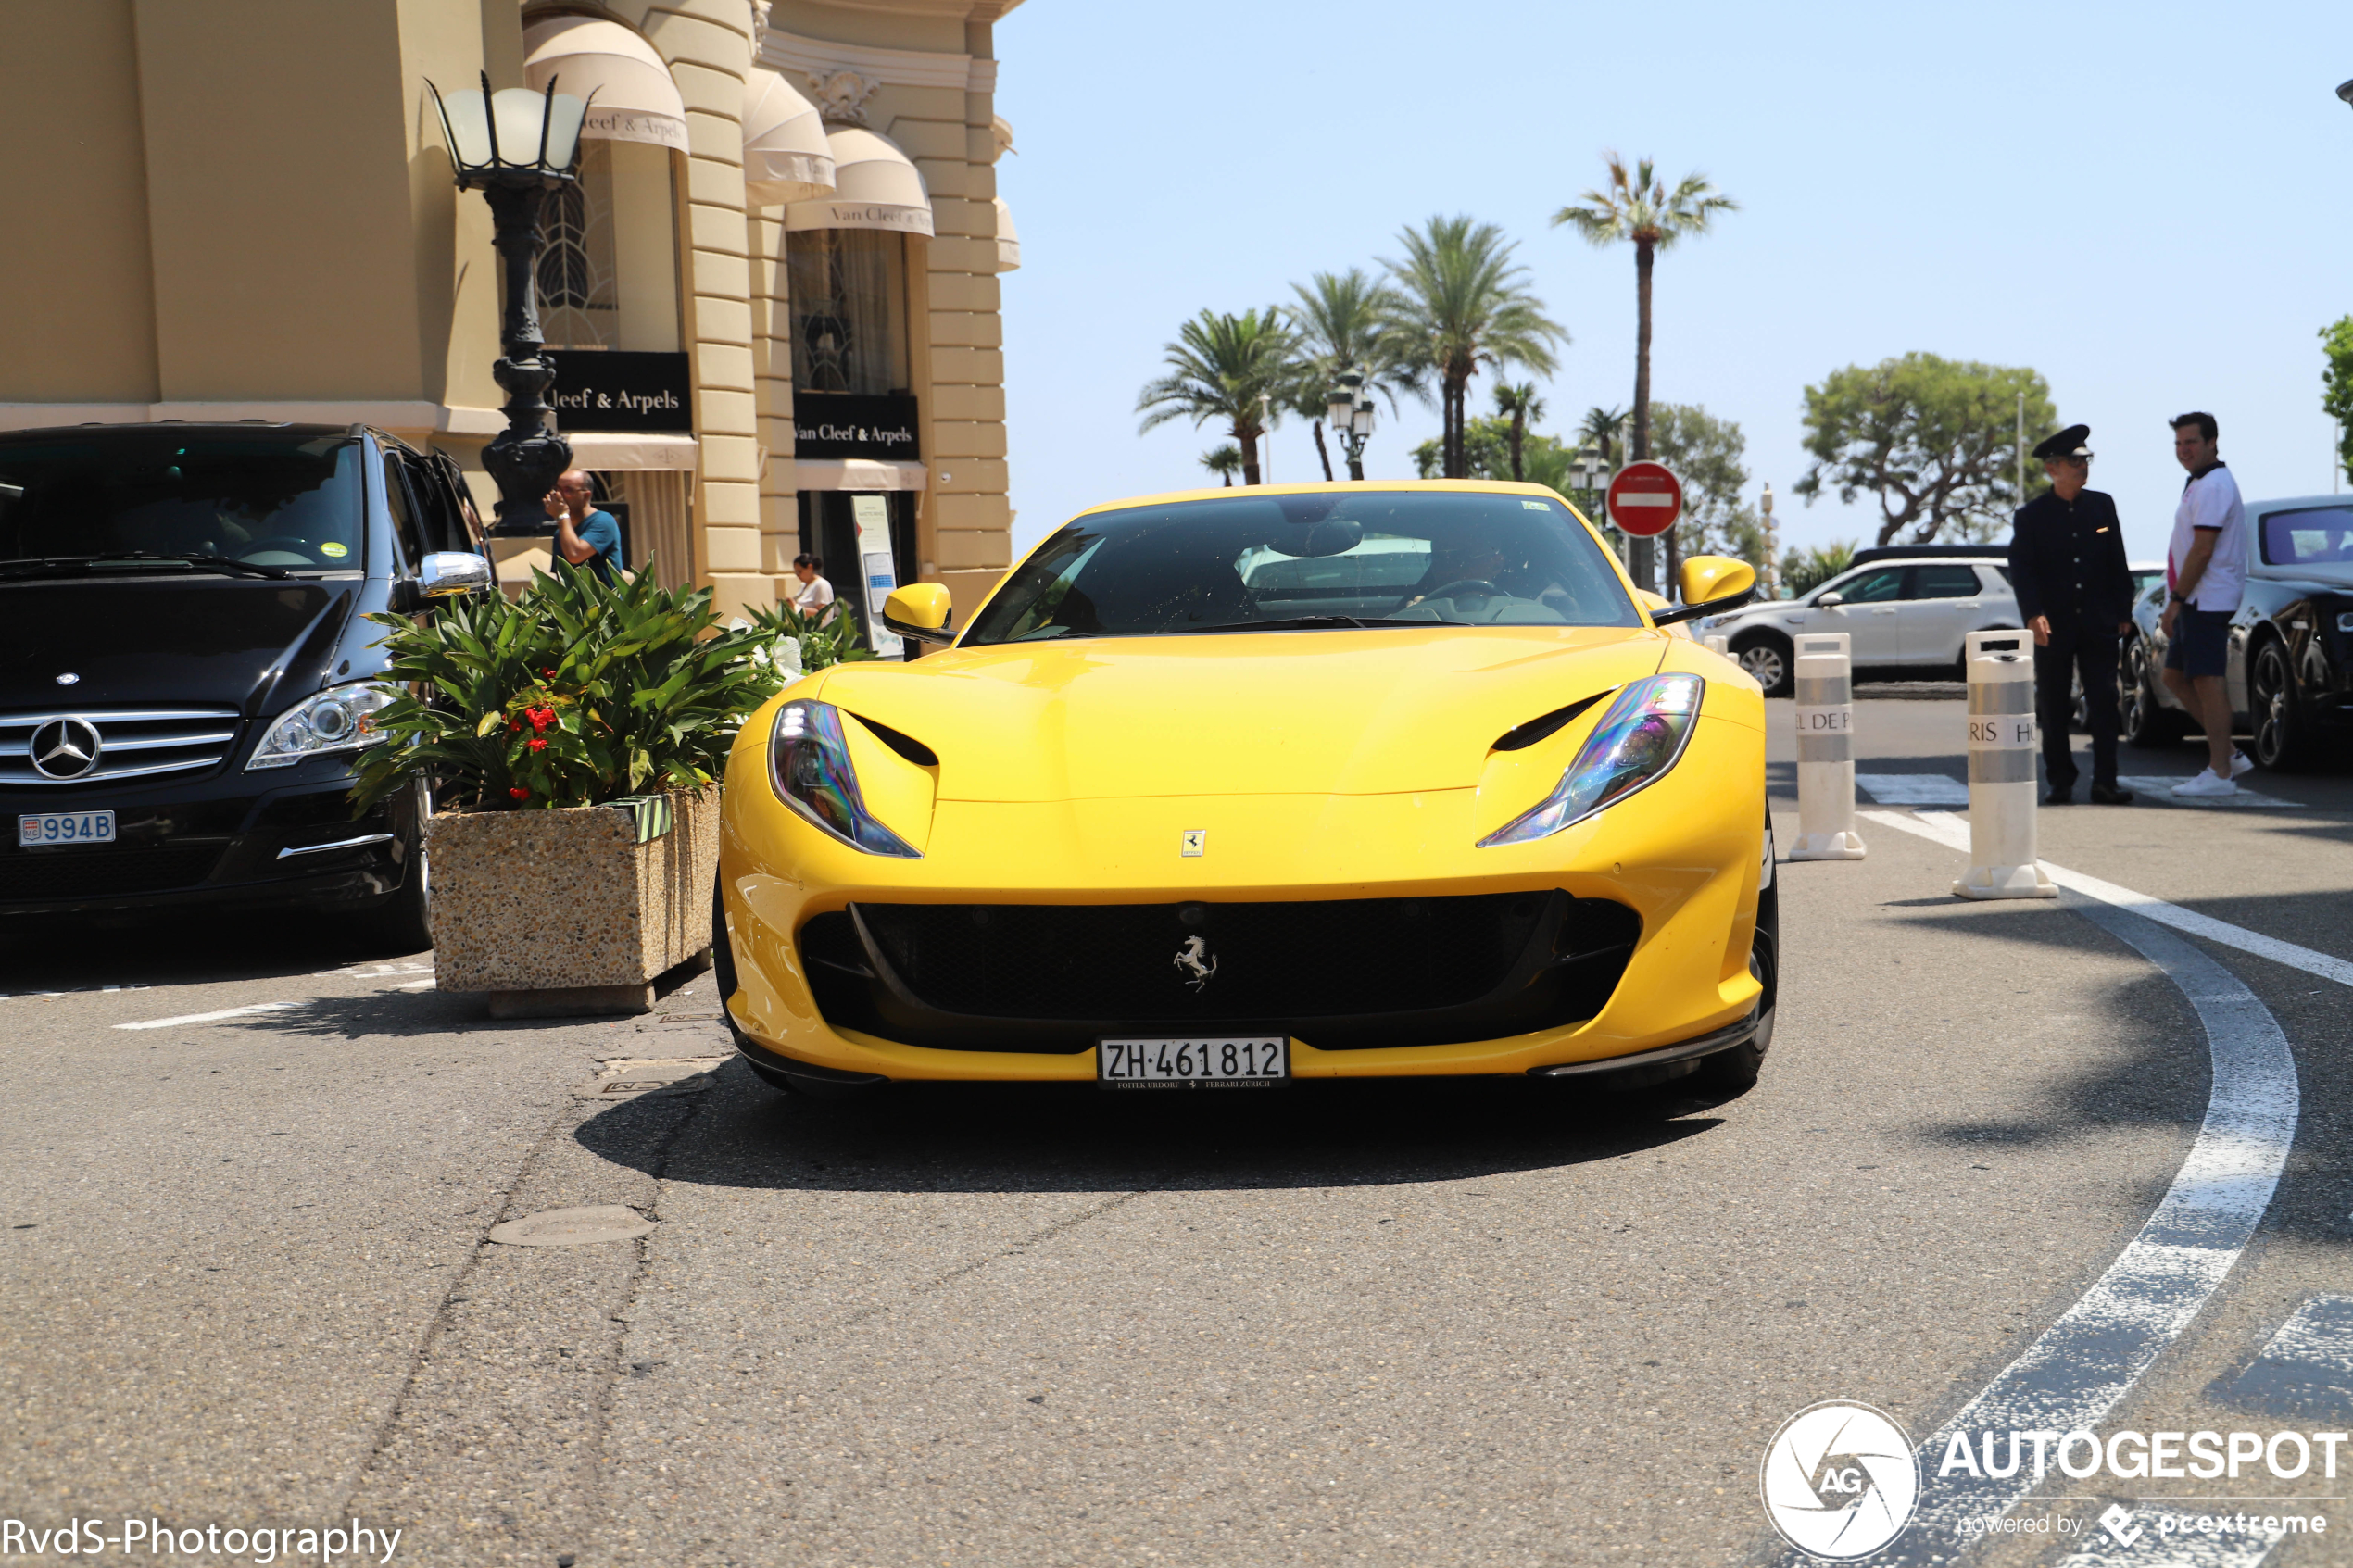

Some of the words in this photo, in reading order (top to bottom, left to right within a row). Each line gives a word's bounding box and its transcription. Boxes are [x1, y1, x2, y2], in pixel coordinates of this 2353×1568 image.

[625, 119, 637, 132] &
[831, 207, 862, 221] Van
[596, 393, 612, 408] &
[616, 389, 679, 415] Arpels
[819, 423, 856, 441] Cleef
[857, 428, 869, 442] &
[871, 425, 912, 447] Arpels
[1812, 712, 1838, 730] DE
[44, 816, 111, 840] 994B
[1148, 1081, 1180, 1089] URDORF
[1205, 1080, 1239, 1089] FERRARI
